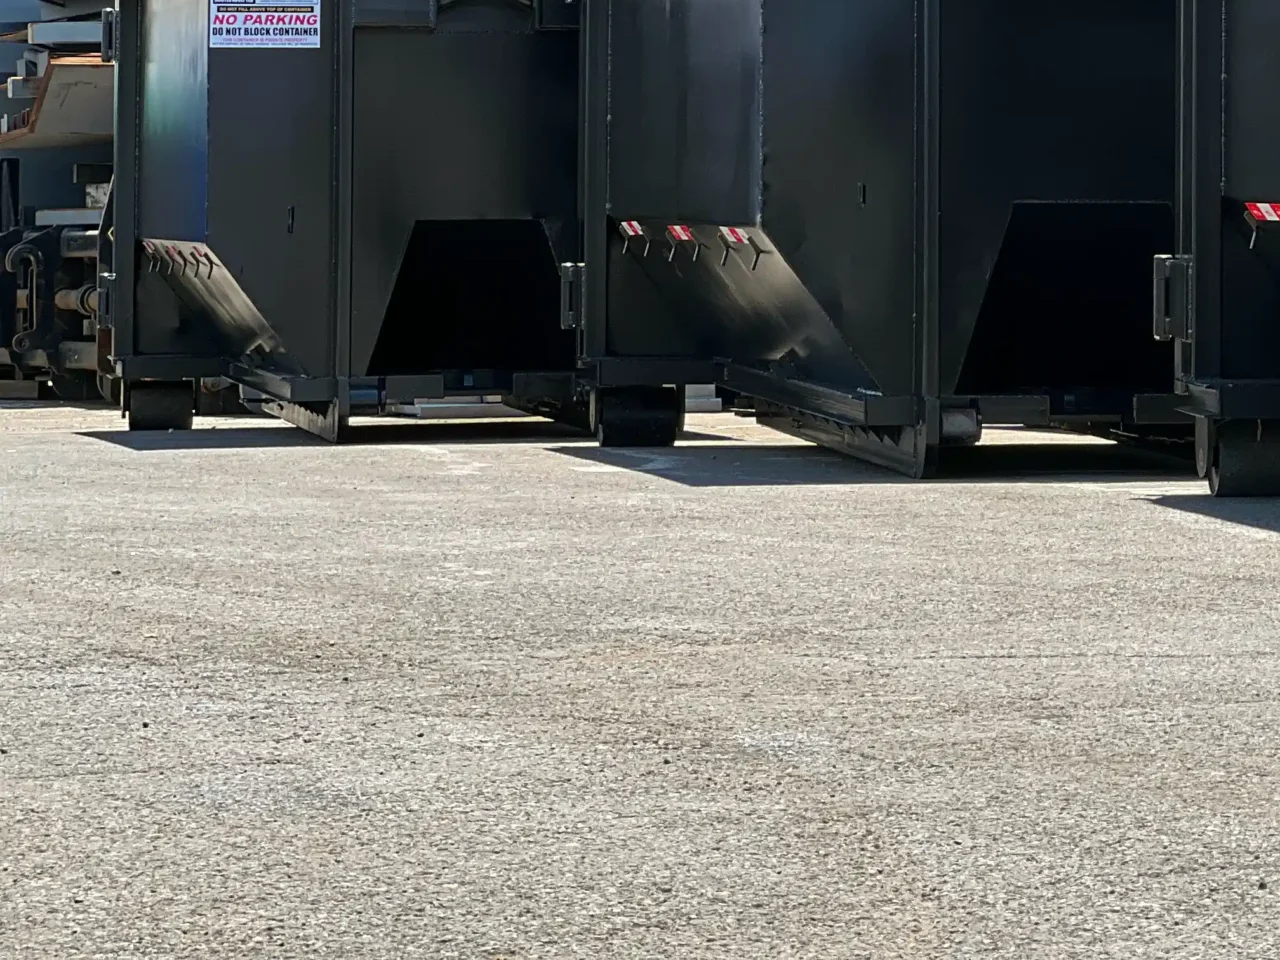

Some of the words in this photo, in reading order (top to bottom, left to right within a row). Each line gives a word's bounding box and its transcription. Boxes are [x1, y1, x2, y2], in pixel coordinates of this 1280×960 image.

[213, 14, 237, 25] NO
[243, 15, 317, 25] PARKING
[212, 27, 223, 36] DO
[226, 27, 242, 36] NOT
[244, 28, 271, 36] BLOCK
[273, 28, 318, 36] CONTAINER
